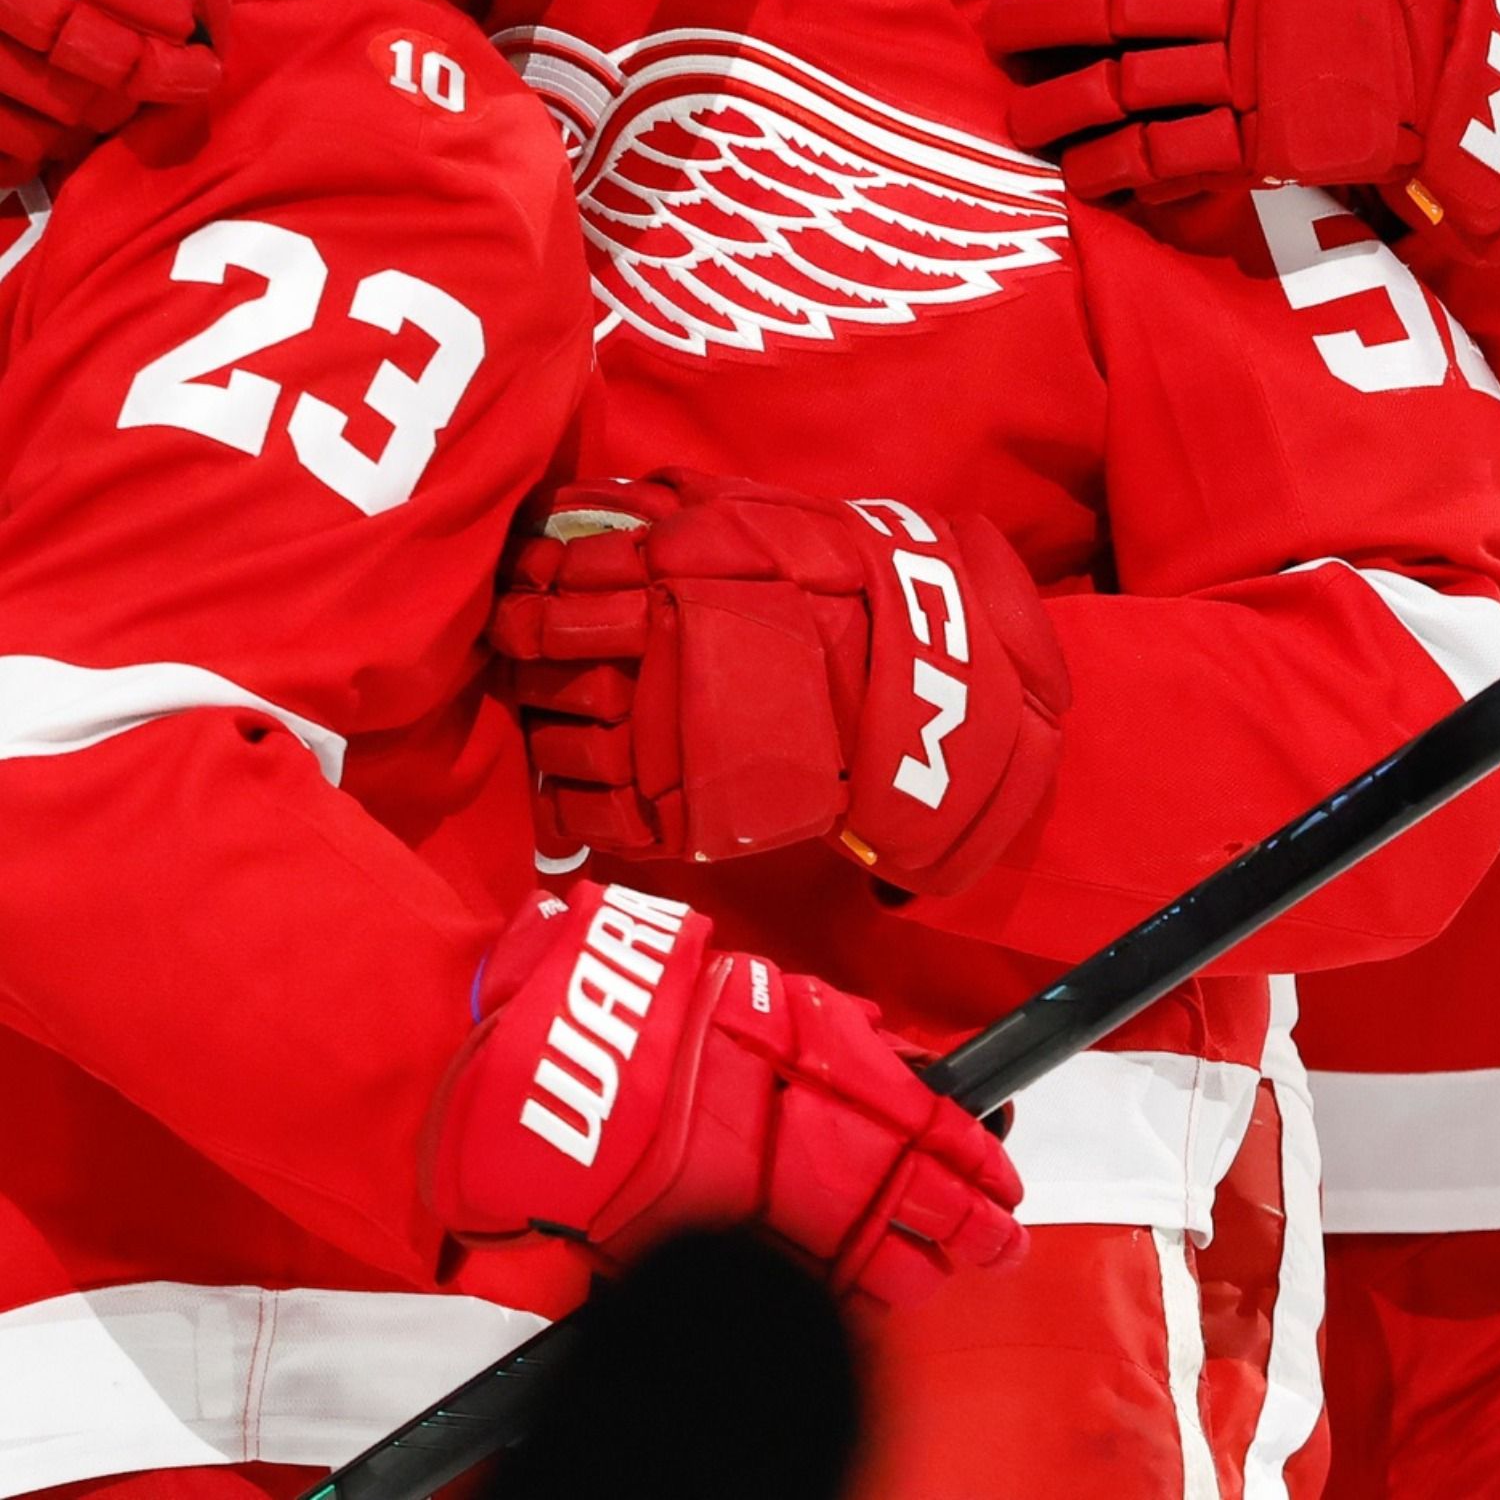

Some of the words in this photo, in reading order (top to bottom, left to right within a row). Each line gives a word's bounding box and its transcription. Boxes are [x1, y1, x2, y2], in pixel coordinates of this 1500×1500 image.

[389, 39, 465, 113] 10
[116, 220, 486, 517] 23
[847, 498, 969, 810] CCM
